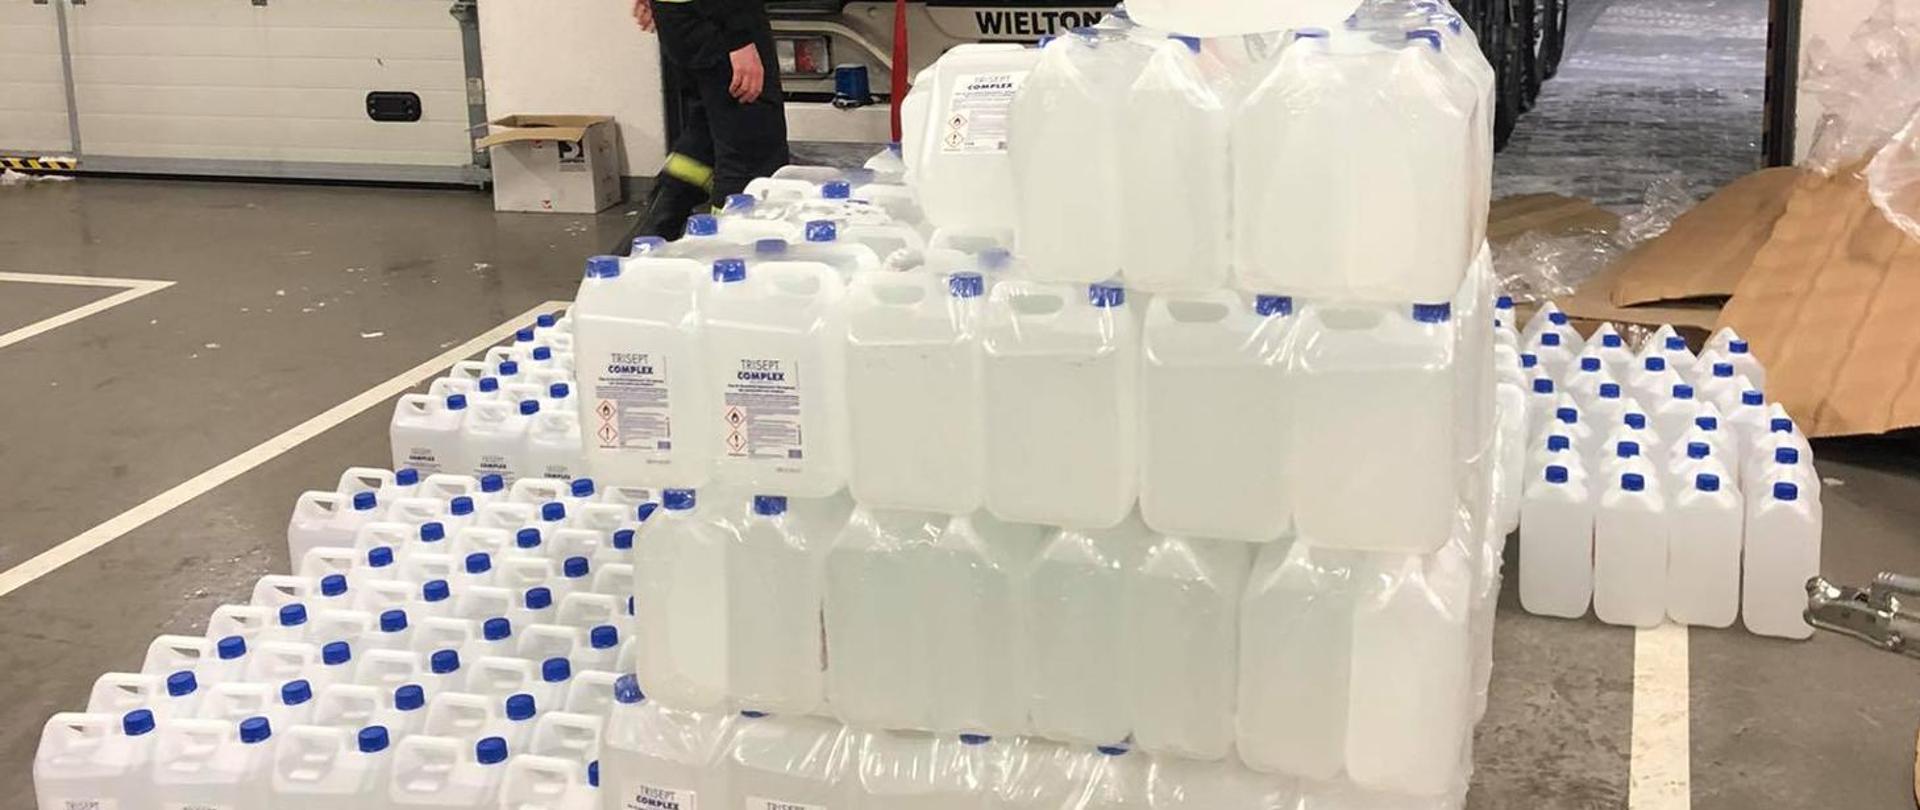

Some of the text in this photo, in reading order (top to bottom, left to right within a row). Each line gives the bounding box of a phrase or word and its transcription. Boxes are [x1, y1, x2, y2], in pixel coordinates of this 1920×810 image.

[975, 11, 1101, 35] WIELTON
[967, 82, 1013, 91] COMPLEX
[611, 352, 649, 365] TRISEPT
[607, 364, 654, 375] COMPLEX
[740, 359, 780, 371] TRISEPT
[737, 371, 785, 381] COMPLEX
[640, 784, 676, 801] TRISEPT
[636, 794, 680, 810] COMPLEX
